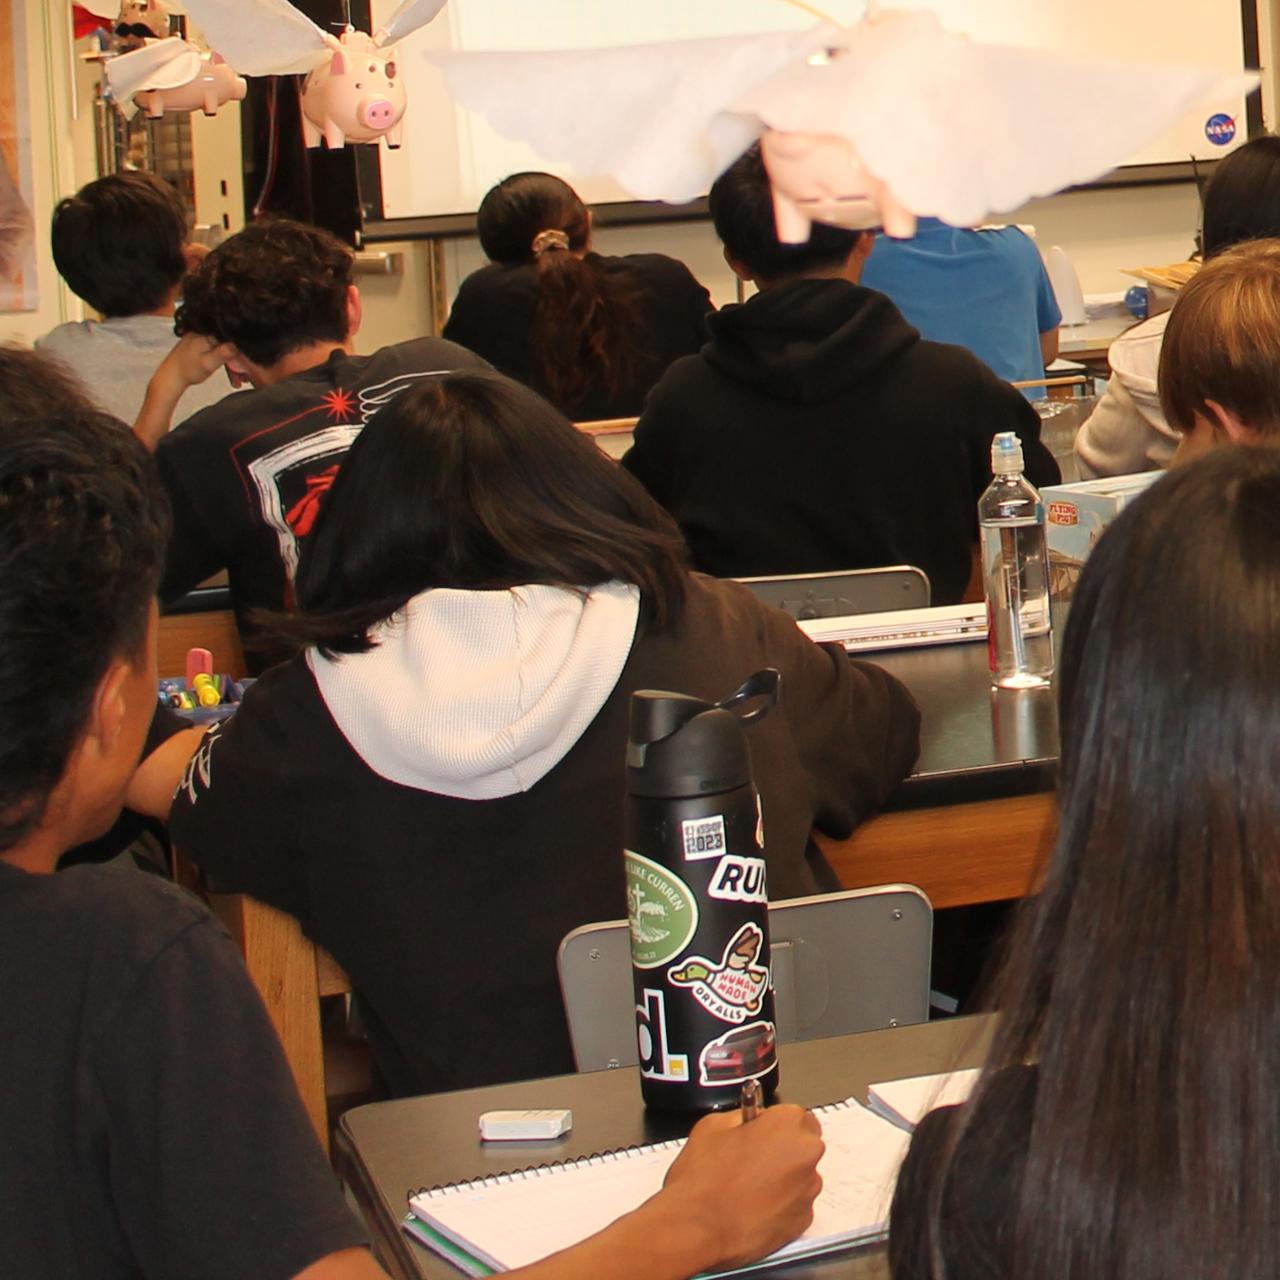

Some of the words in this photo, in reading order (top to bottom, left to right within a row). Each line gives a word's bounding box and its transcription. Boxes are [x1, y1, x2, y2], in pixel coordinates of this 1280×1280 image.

[686, 833, 723, 855] 2023
[718, 982, 748, 1000] MADE
[719, 974, 757, 993] HUMAN
